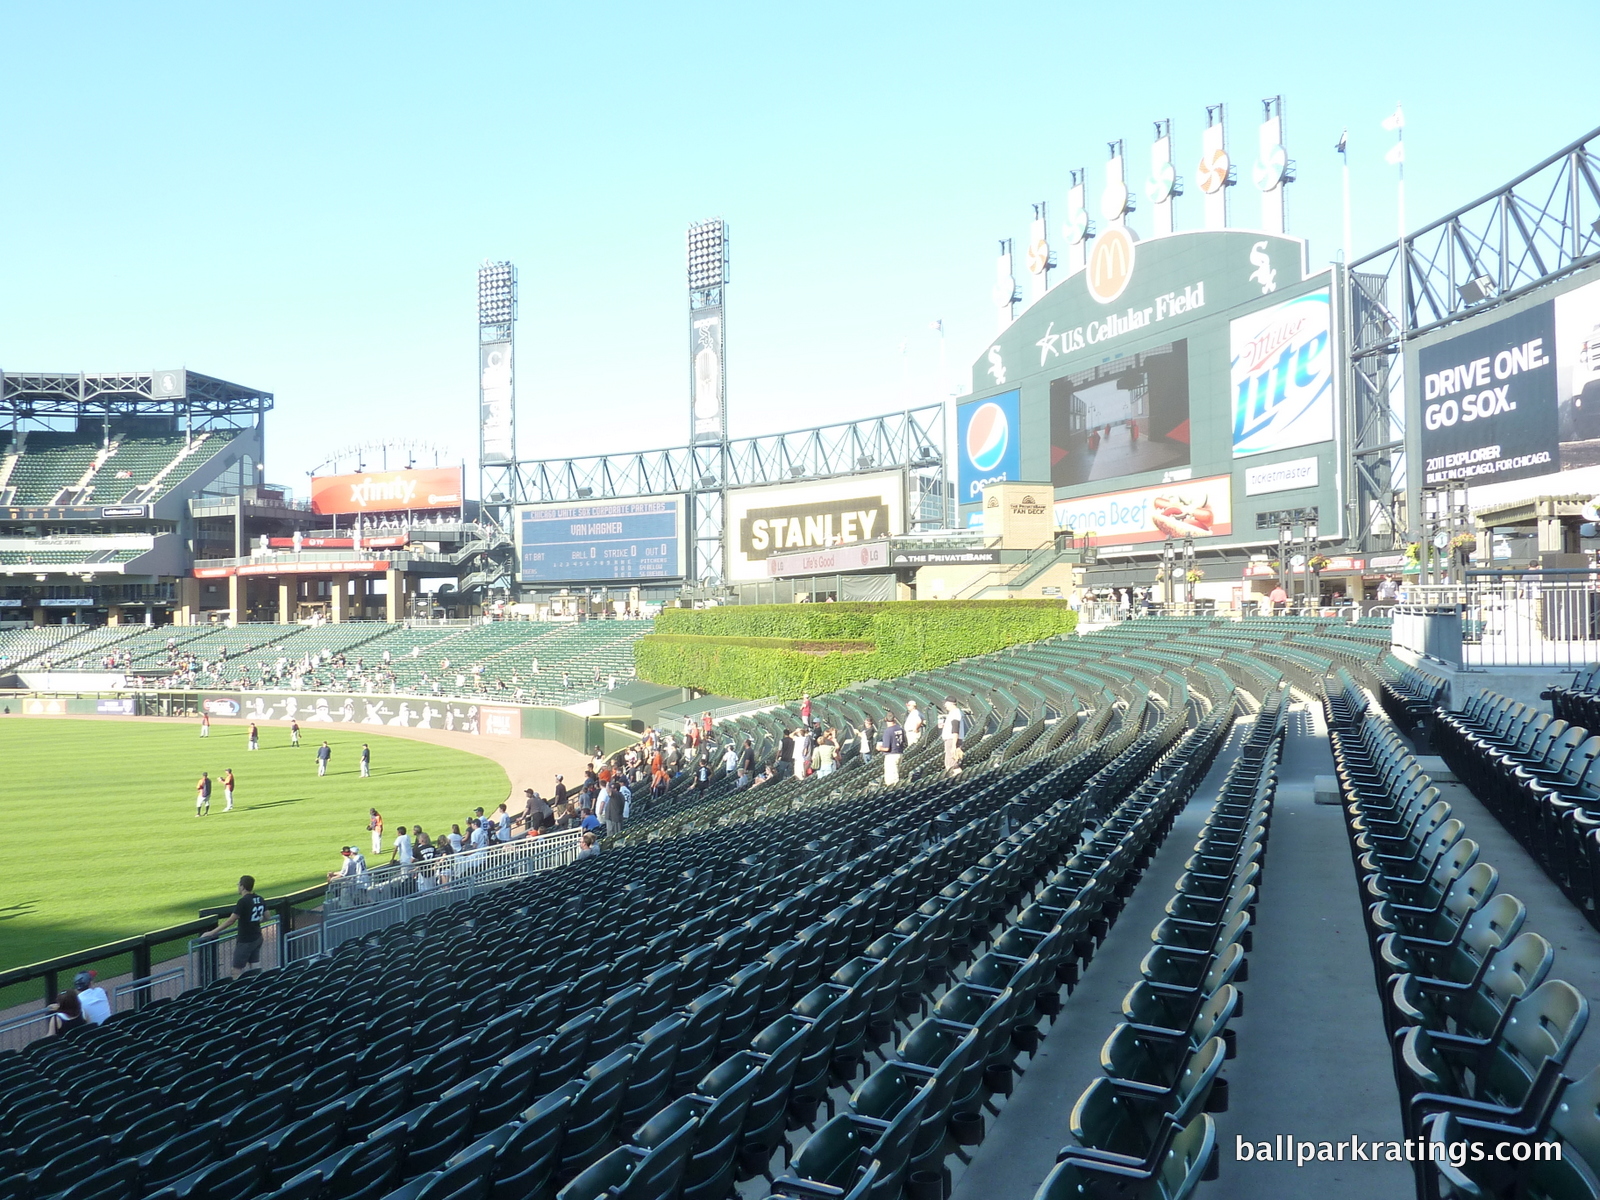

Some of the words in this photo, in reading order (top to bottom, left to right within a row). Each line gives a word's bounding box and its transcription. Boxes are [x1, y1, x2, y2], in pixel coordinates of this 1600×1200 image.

[1061, 327, 1086, 354] U.S.
[1086, 306, 1153, 345] Cellular
[1155, 281, 1205, 322] Field
[1242, 318, 1306, 367] Miller
[1425, 356, 1491, 400] DRIVE
[1494, 337, 1549, 380] ONE.
[1232, 329, 1328, 446] Lite
[1425, 400, 1459, 431] GO
[1462, 384, 1517, 422] SOX.
[1426, 456, 1444, 471] 2011
[1445, 445, 1501, 468] EXPLORER
[1426, 472, 1448, 484] BUILT
[1448, 470, 1457, 479] IN
[1457, 463, 1496, 478] CHICAGO,
[1496, 458, 1512, 472] FOR
[1513, 451, 1551, 468] CHICAGO.
[970, 472, 1006, 498] pei
[1252, 466, 1311, 484] ticketmaster
[530, 509, 556, 519] CHICAGO
[558, 508, 576, 518] WHITE
[578, 507, 591, 516] SOX
[592, 504, 629, 516] CORPORATE
[630, 502, 666, 513] PARTNERS
[1055, 509, 1106, 531] Vienna
[1110, 498, 1147, 529] Beef
[570, 524, 587, 536] VAN
[588, 522, 623, 535] WAGNER
[752, 510, 878, 550] STANLEY
[534, 553, 545, 561] BAT
[572, 551, 587, 559] BALL
[604, 549, 628, 558] STRIKE
[646, 548, 658, 556] OUT
[802, 556, 818, 570] Life's
[818, 555, 834, 568] Good
[870, 551, 878, 561] LG
[777, 561, 784, 571] LG
